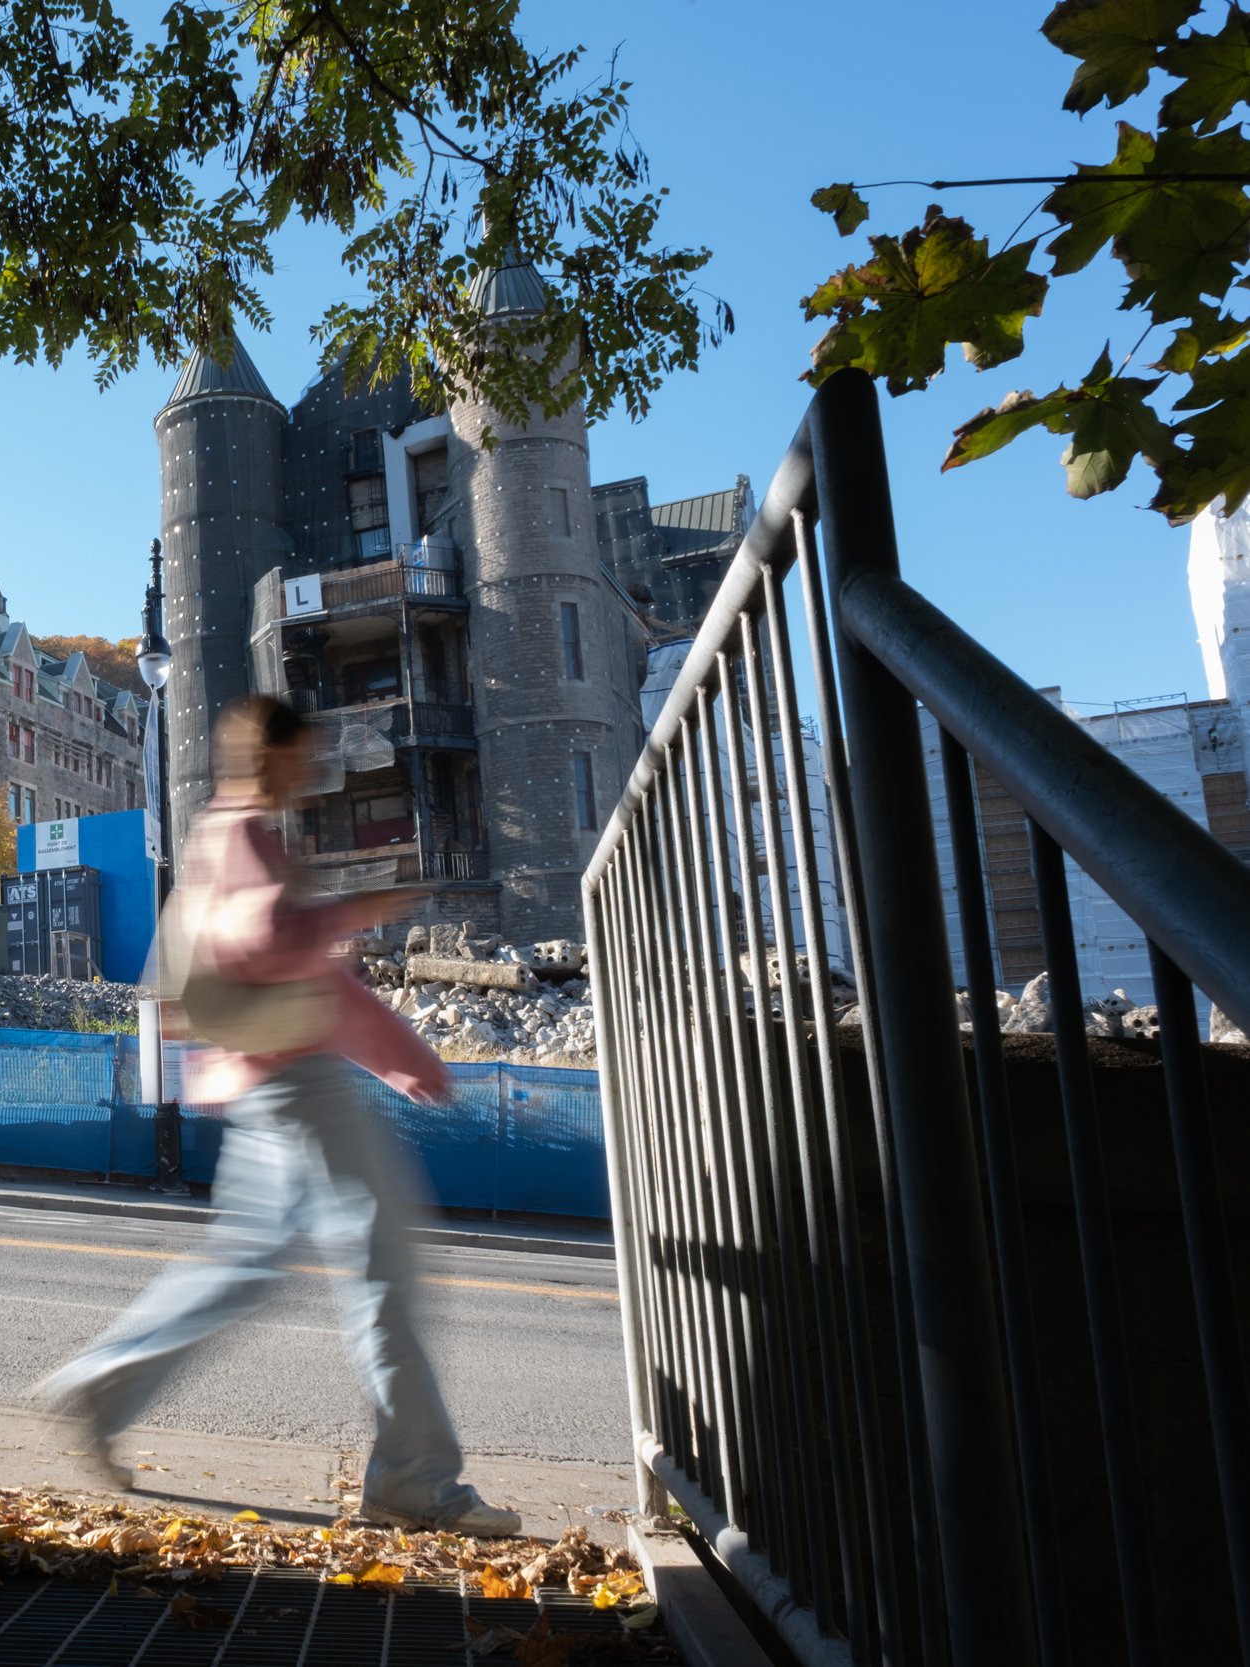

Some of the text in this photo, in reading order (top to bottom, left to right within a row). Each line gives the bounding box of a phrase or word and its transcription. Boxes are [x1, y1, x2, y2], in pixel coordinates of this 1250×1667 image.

[295, 586, 309, 606] L
[38, 845, 76, 853] RASSEMBLEMENT
[9, 886, 36, 900] ATS
